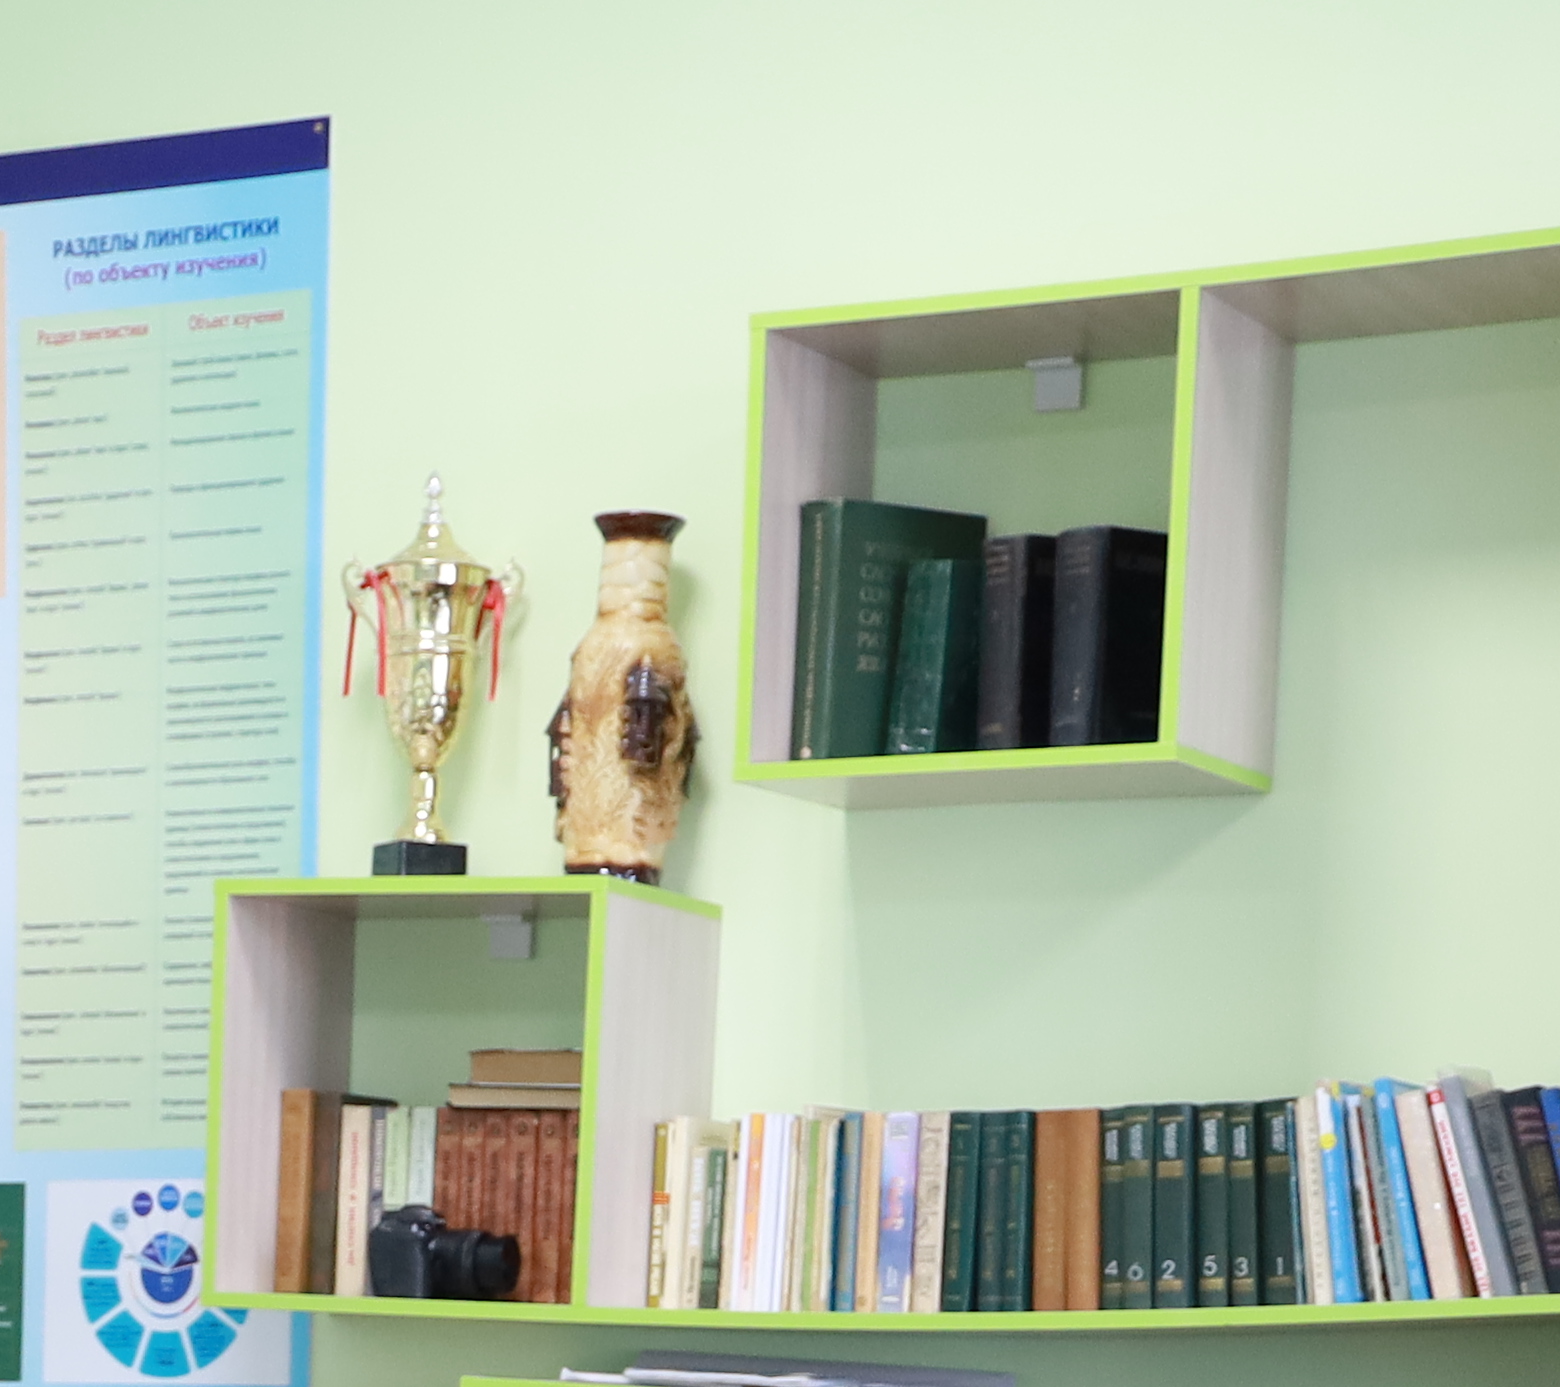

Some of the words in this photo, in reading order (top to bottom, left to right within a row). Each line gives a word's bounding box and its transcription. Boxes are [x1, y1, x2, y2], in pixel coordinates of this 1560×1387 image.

[53, 231, 138, 258] РАЗДЕЛЫ
[143, 216, 280, 250] ЛИНГВИСТИКИ
[64, 266, 94, 290] (по
[98, 262, 170, 284] объекту
[175, 247, 267, 276] изучения)
[1104, 1260, 1118, 1276] 4
[1127, 1262, 1144, 1281] 6
[1161, 1260, 1176, 1280] 2
[1203, 1254, 1218, 1276] 5
[1235, 1257, 1249, 1278] 3
[1276, 1256, 1284, 1276] 1
